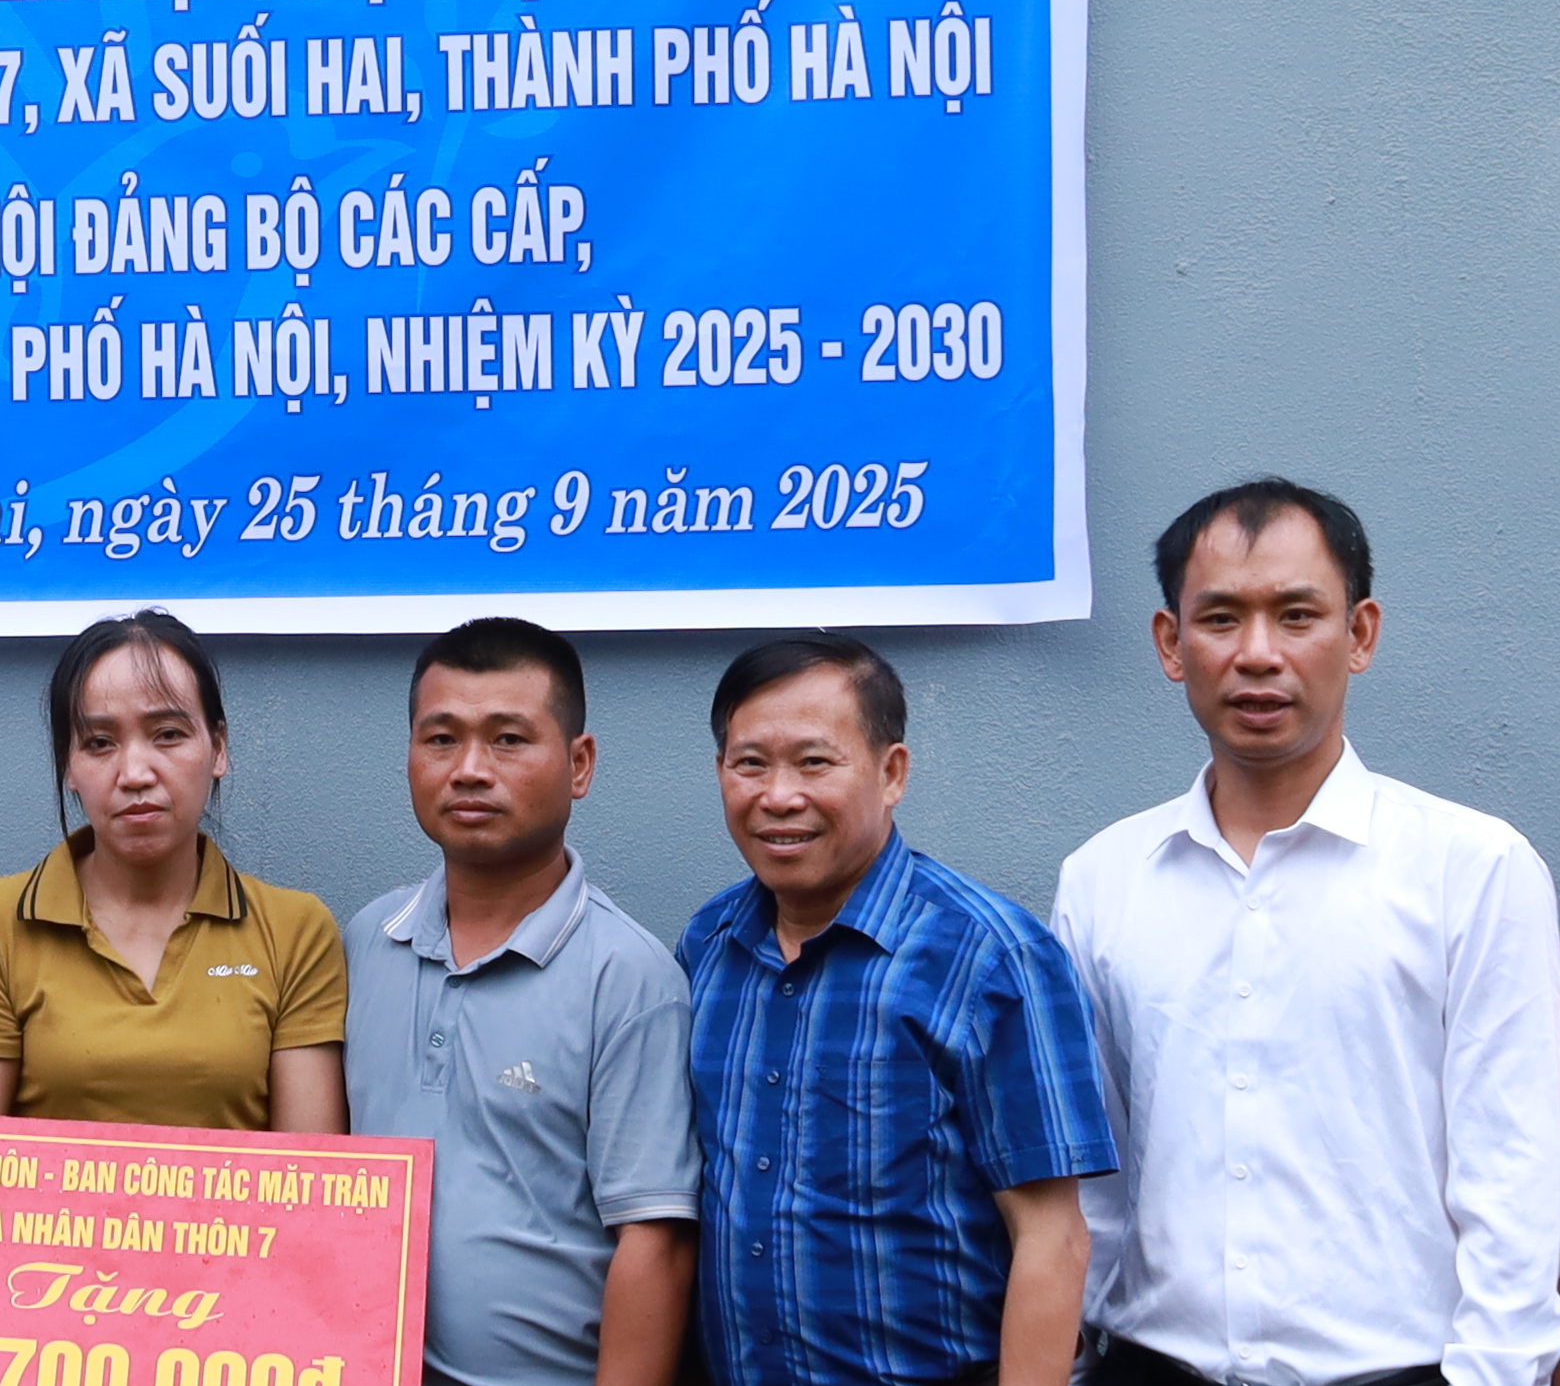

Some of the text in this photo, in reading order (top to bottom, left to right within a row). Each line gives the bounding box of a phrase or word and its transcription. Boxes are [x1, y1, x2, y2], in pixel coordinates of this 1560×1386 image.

[56, 28, 136, 123] XÃ
[152, 13, 287, 119] SUỐI
[306, 34, 421, 122] HAI,
[439, 15, 633, 111] THÀNH
[790, 5, 872, 100] HÀ
[889, 1, 992, 113] NỘI
[72, 172, 227, 274] ĐẢNG
[246, 176, 320, 286] BỘ
[339, 173, 452, 268] CÁC
[471, 158, 592, 271] CẤP,
[11, 295, 122, 402] PHỐ
[140, 305, 217, 399] HÀ
[233, 303, 348, 412] NỘI,
[366, 297, 553, 409] NHIỆM
[572, 295, 645, 389] KỲ
[661, 307, 802, 388] 2025
[821, 341, 842, 358] -
[860, 301, 1003, 382] 2030
[63, 477, 228, 558] ngày
[239, 475, 320, 541] 25
[338, 472, 536, 553] tháng
[550, 470, 590, 535] 9
[606, 467, 754, 534] năm
[770, 461, 929, 529] 2025
[11, 1206, 94, 1248] NHÂN
[103, 1213, 163, 1253] DÂN
[173, 1218, 251, 1258] THÔN
[258, 1227, 276, 1259] 7
[63, 1159, 115, 1195] BAN
[123, 1157, 194, 1199] CÔNG
[203, 1160, 250, 1202] TÁC
[258, 1165, 316, 1211] MẶT
[321, 1168, 389, 1213] TRẬN
[7, 1262, 225, 1329] Tặng
